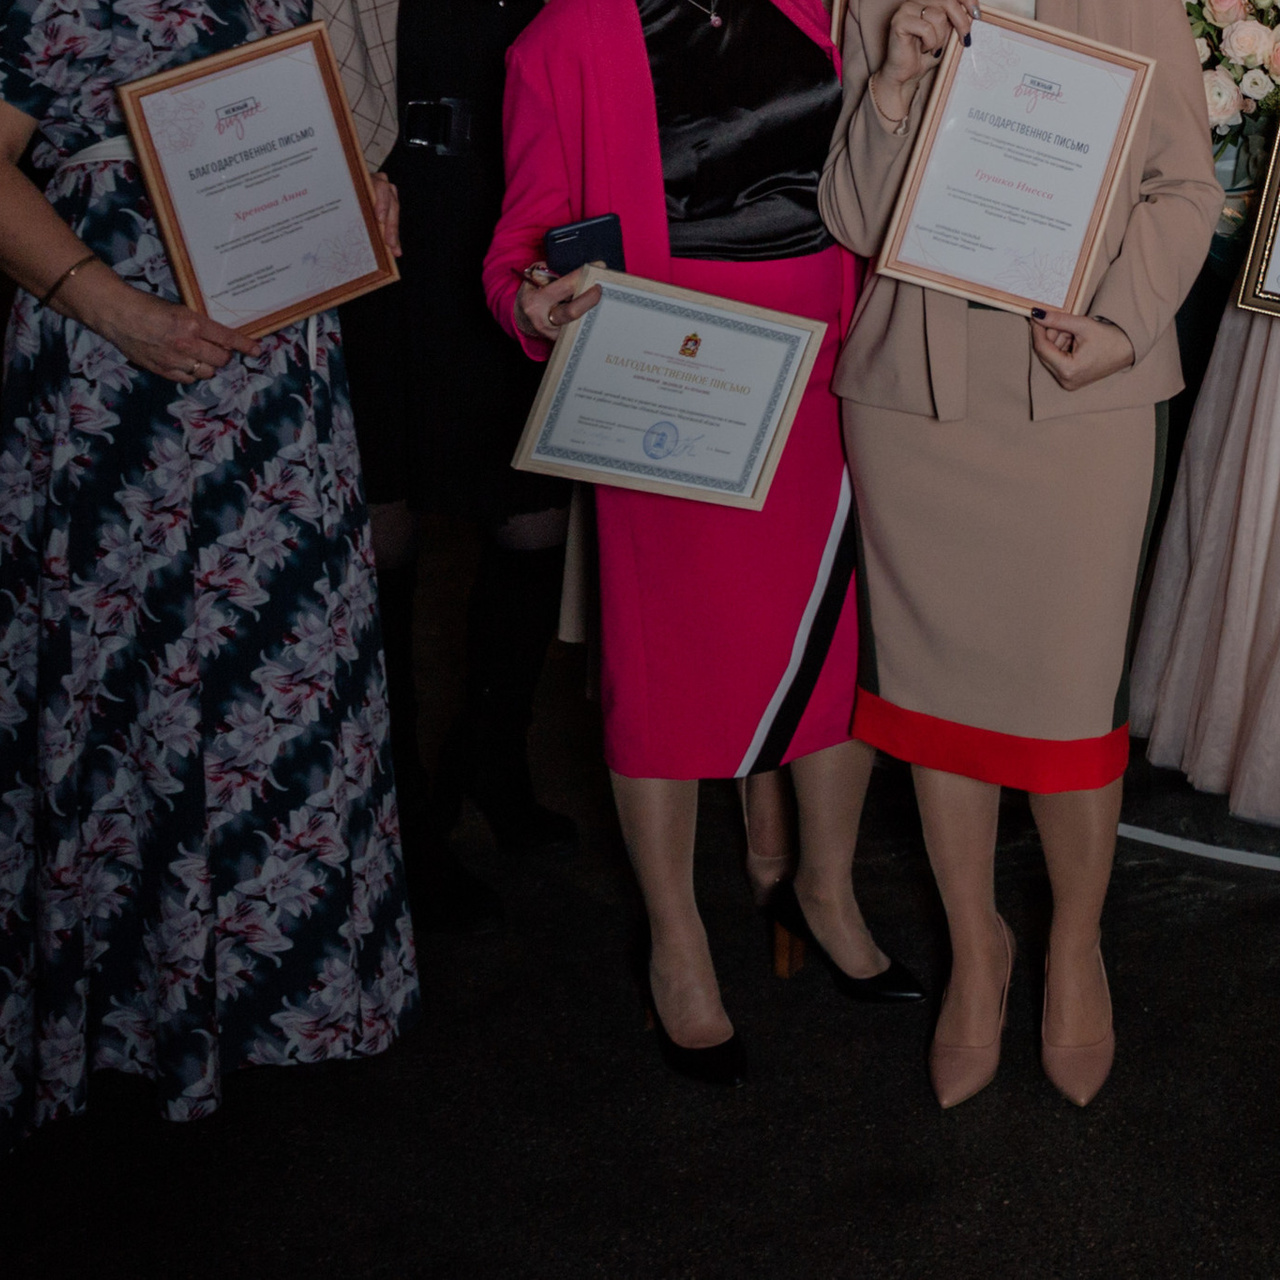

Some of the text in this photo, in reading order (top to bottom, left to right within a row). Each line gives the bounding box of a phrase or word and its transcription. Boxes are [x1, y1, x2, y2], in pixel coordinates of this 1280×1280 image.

[967, 107, 1053, 143] БЛАГОДАРСТВЕННОЕ
[1054, 134, 1090, 154] ПИСЬМО
[189, 140, 277, 181] БЛАГОДАРСТВЕННОЕ
[279, 126, 315, 148] ПИСЬМО
[281, 188, 308, 204] Анна
[975, 168, 1054, 201] Грушко Инесса
[605, 353, 708, 386] БЛАГОДАРСТВЕННОЕ
[710, 378, 751, 395] ПИСЬМО
